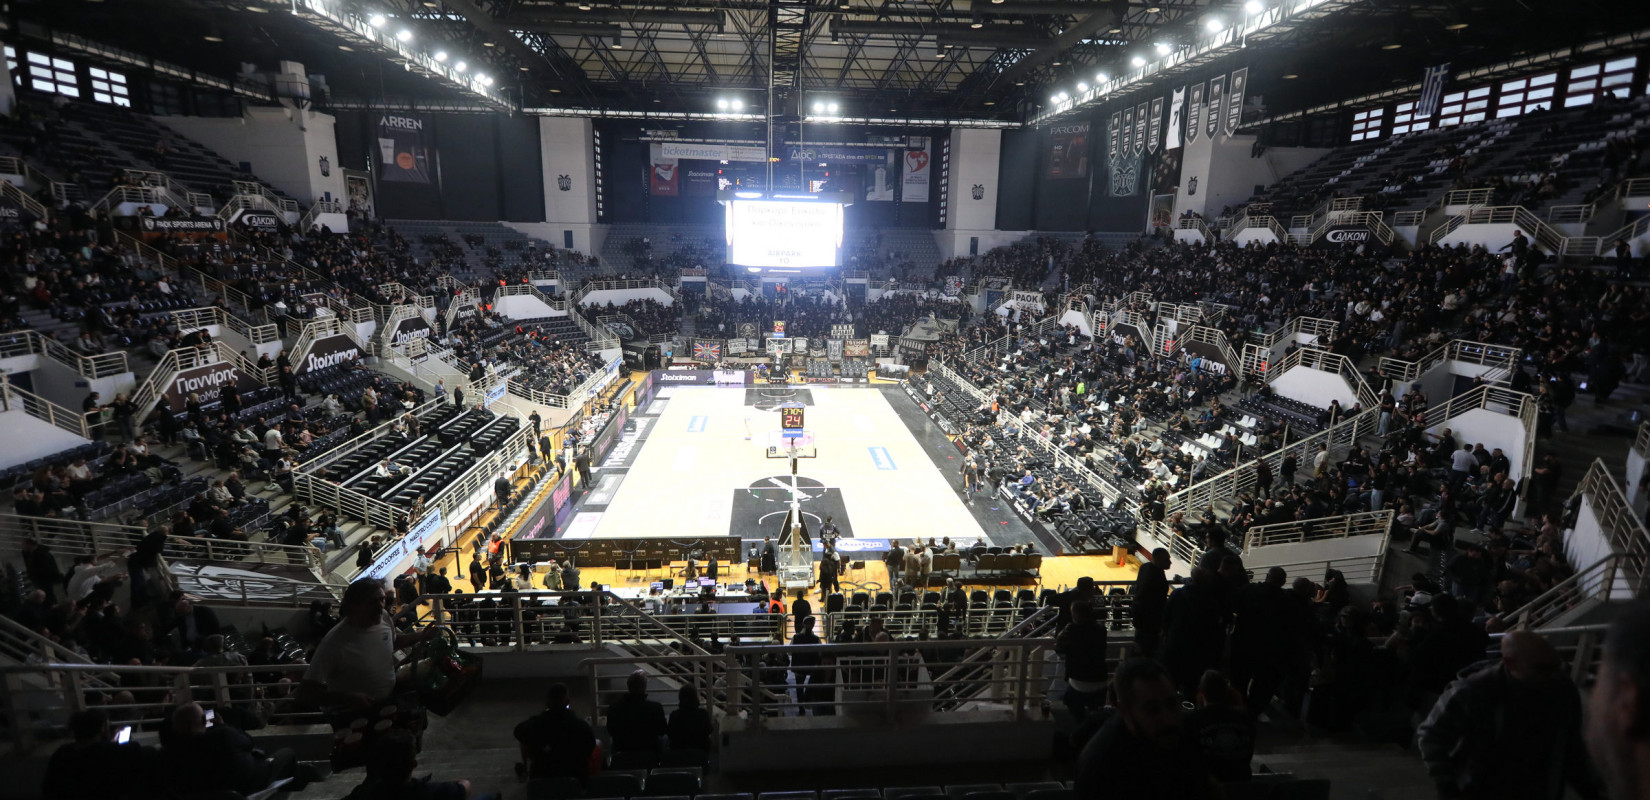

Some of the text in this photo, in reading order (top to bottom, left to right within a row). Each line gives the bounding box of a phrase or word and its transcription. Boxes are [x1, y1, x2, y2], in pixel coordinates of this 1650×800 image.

[663, 146, 723, 158] ticketmaster
[173, 220, 195, 229] SPORTS
[1015, 293, 1039, 304] PAOK
[176, 367, 239, 395] Γιαννίρης
[660, 373, 697, 382] Stoiximan
[785, 415, 801, 426] 24
